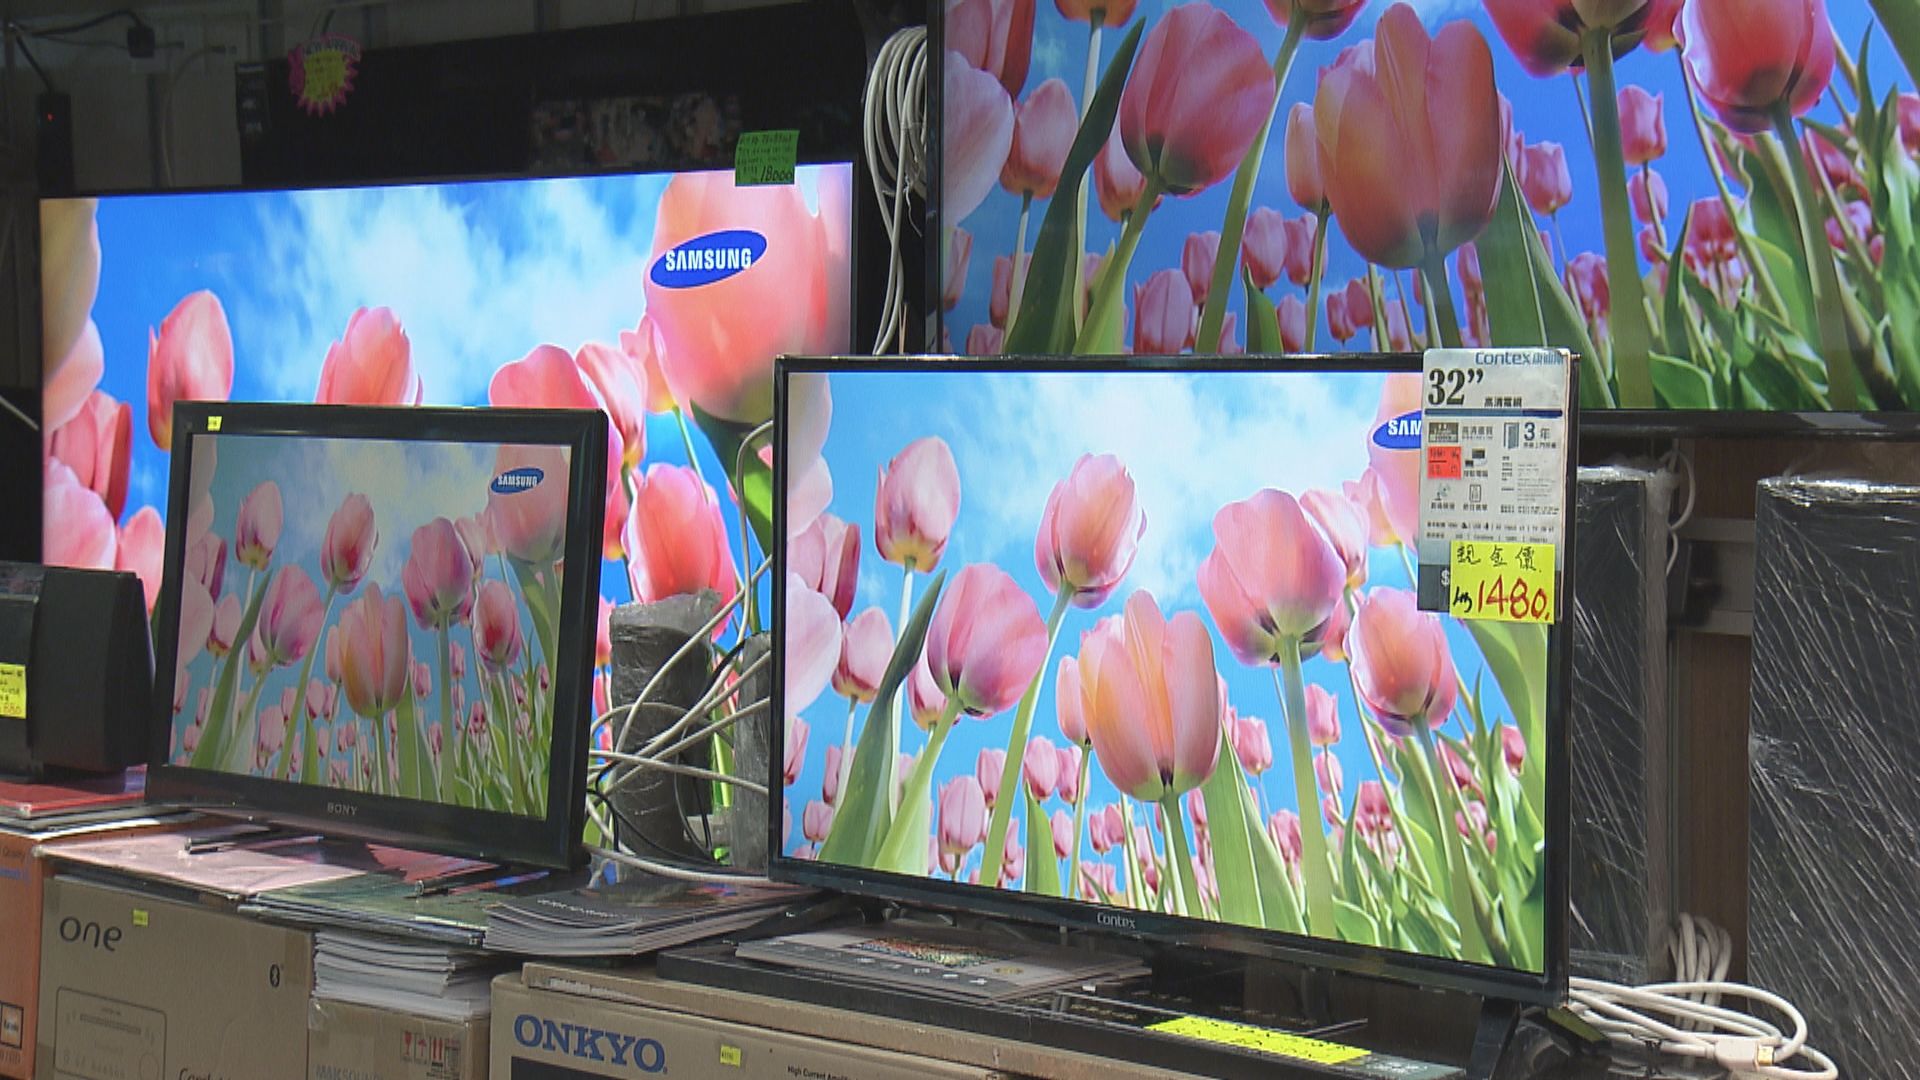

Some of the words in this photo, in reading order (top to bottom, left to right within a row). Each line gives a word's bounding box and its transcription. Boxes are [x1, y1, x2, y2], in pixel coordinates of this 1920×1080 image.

[665, 247, 752, 272] SAMSUNG
[1475, 351, 1531, 365] Contex
[498, 474, 538, 488] SAMSUNG
[327, 801, 358, 816] SONY
[1096, 911, 1136, 929] Contex
[60, 917, 122, 952] one
[513, 1013, 668, 1074] ONKYO
